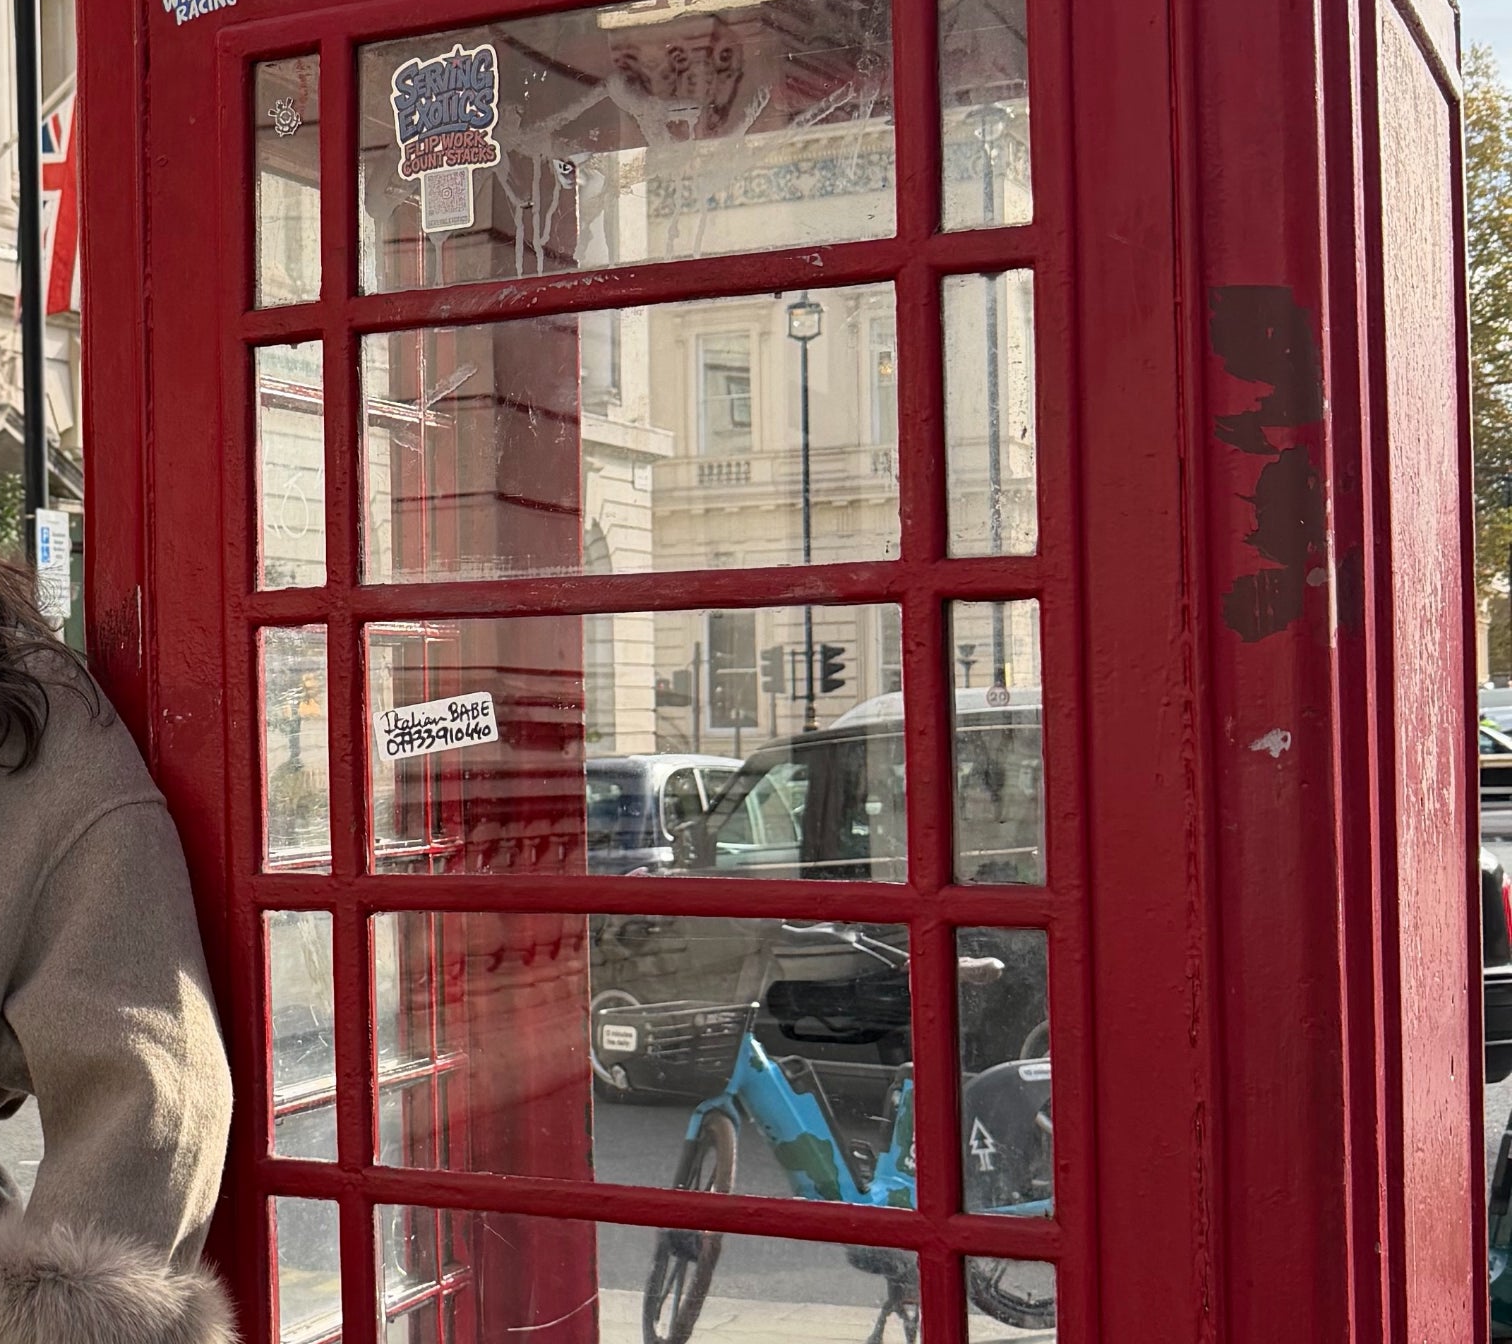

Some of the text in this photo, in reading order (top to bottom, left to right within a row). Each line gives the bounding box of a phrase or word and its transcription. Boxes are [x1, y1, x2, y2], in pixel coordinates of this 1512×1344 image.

[394, 49, 495, 110] SERVING
[396, 87, 494, 144] EXOTICS
[402, 144, 497, 176] COUNT STACKS
[404, 129, 488, 160] FLIP WORK
[990, 691, 1007, 704] 20
[380, 701, 493, 735] Italian BABE
